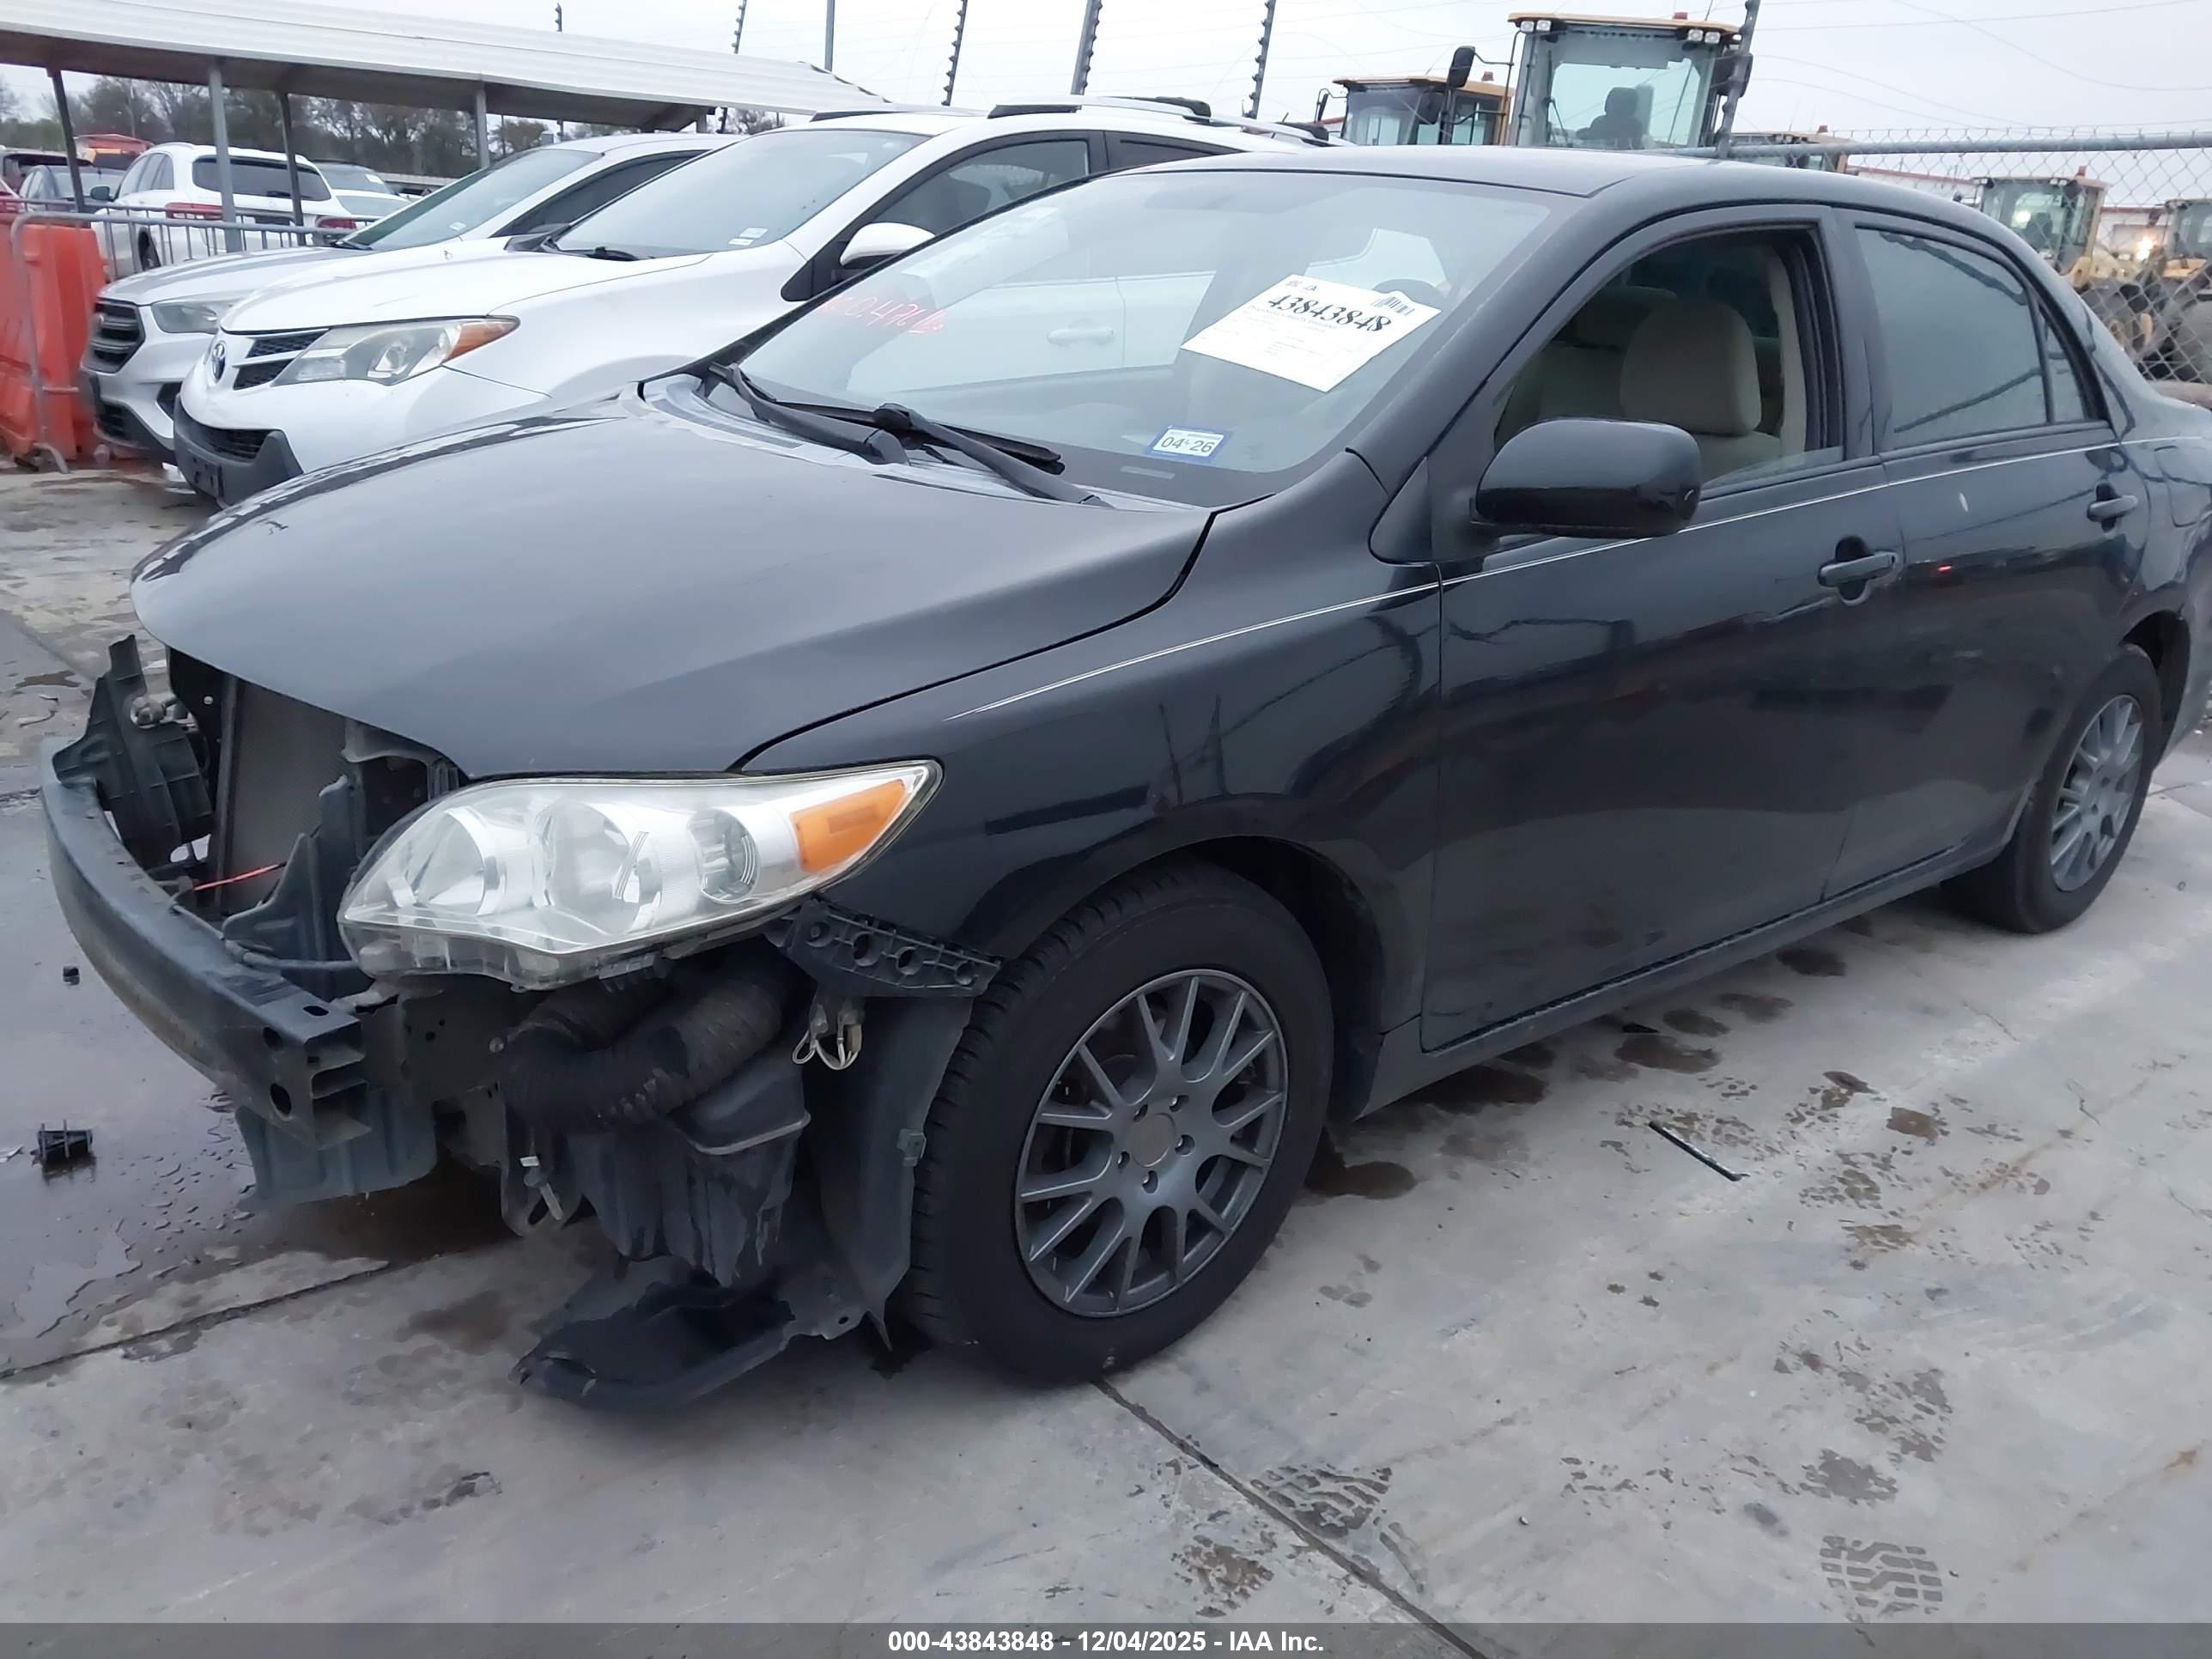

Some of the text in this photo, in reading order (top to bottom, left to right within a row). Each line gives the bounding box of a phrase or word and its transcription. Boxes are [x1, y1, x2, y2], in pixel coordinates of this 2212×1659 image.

[1267, 295, 1391, 331] 43843848
[1160, 436, 1185, 449] 04
[1189, 440, 1216, 453] 26
